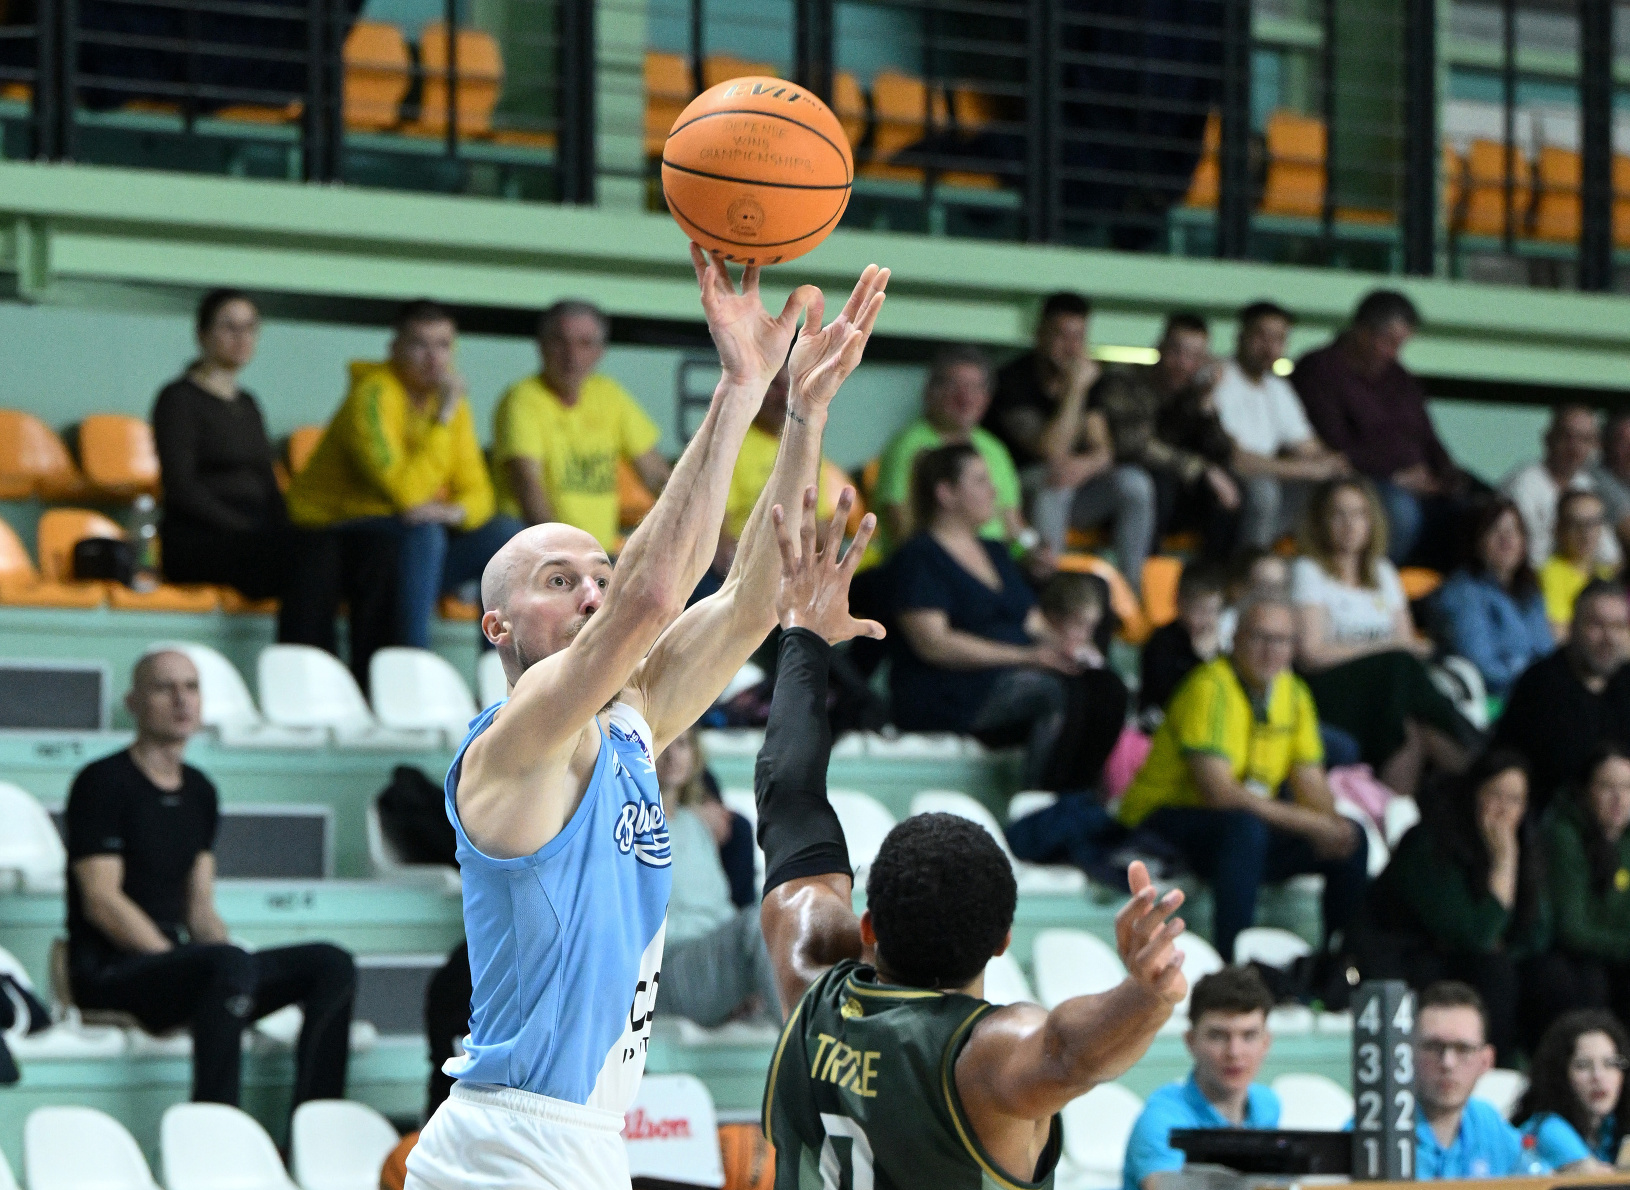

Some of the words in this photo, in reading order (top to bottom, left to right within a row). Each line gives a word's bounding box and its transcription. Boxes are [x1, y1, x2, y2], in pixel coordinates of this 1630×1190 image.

[733, 136, 770, 148] WINS
[613, 799, 664, 855] Blue
[1357, 996, 1381, 1035] 4
[1392, 994, 1415, 1035] 4
[1357, 1043, 1382, 1084] 3
[1394, 1043, 1415, 1084] 3
[1359, 1090, 1382, 1131] 2
[1394, 1089, 1415, 1131] 2
[1363, 1137, 1379, 1178] 1
[1398, 1137, 1411, 1178] 1
